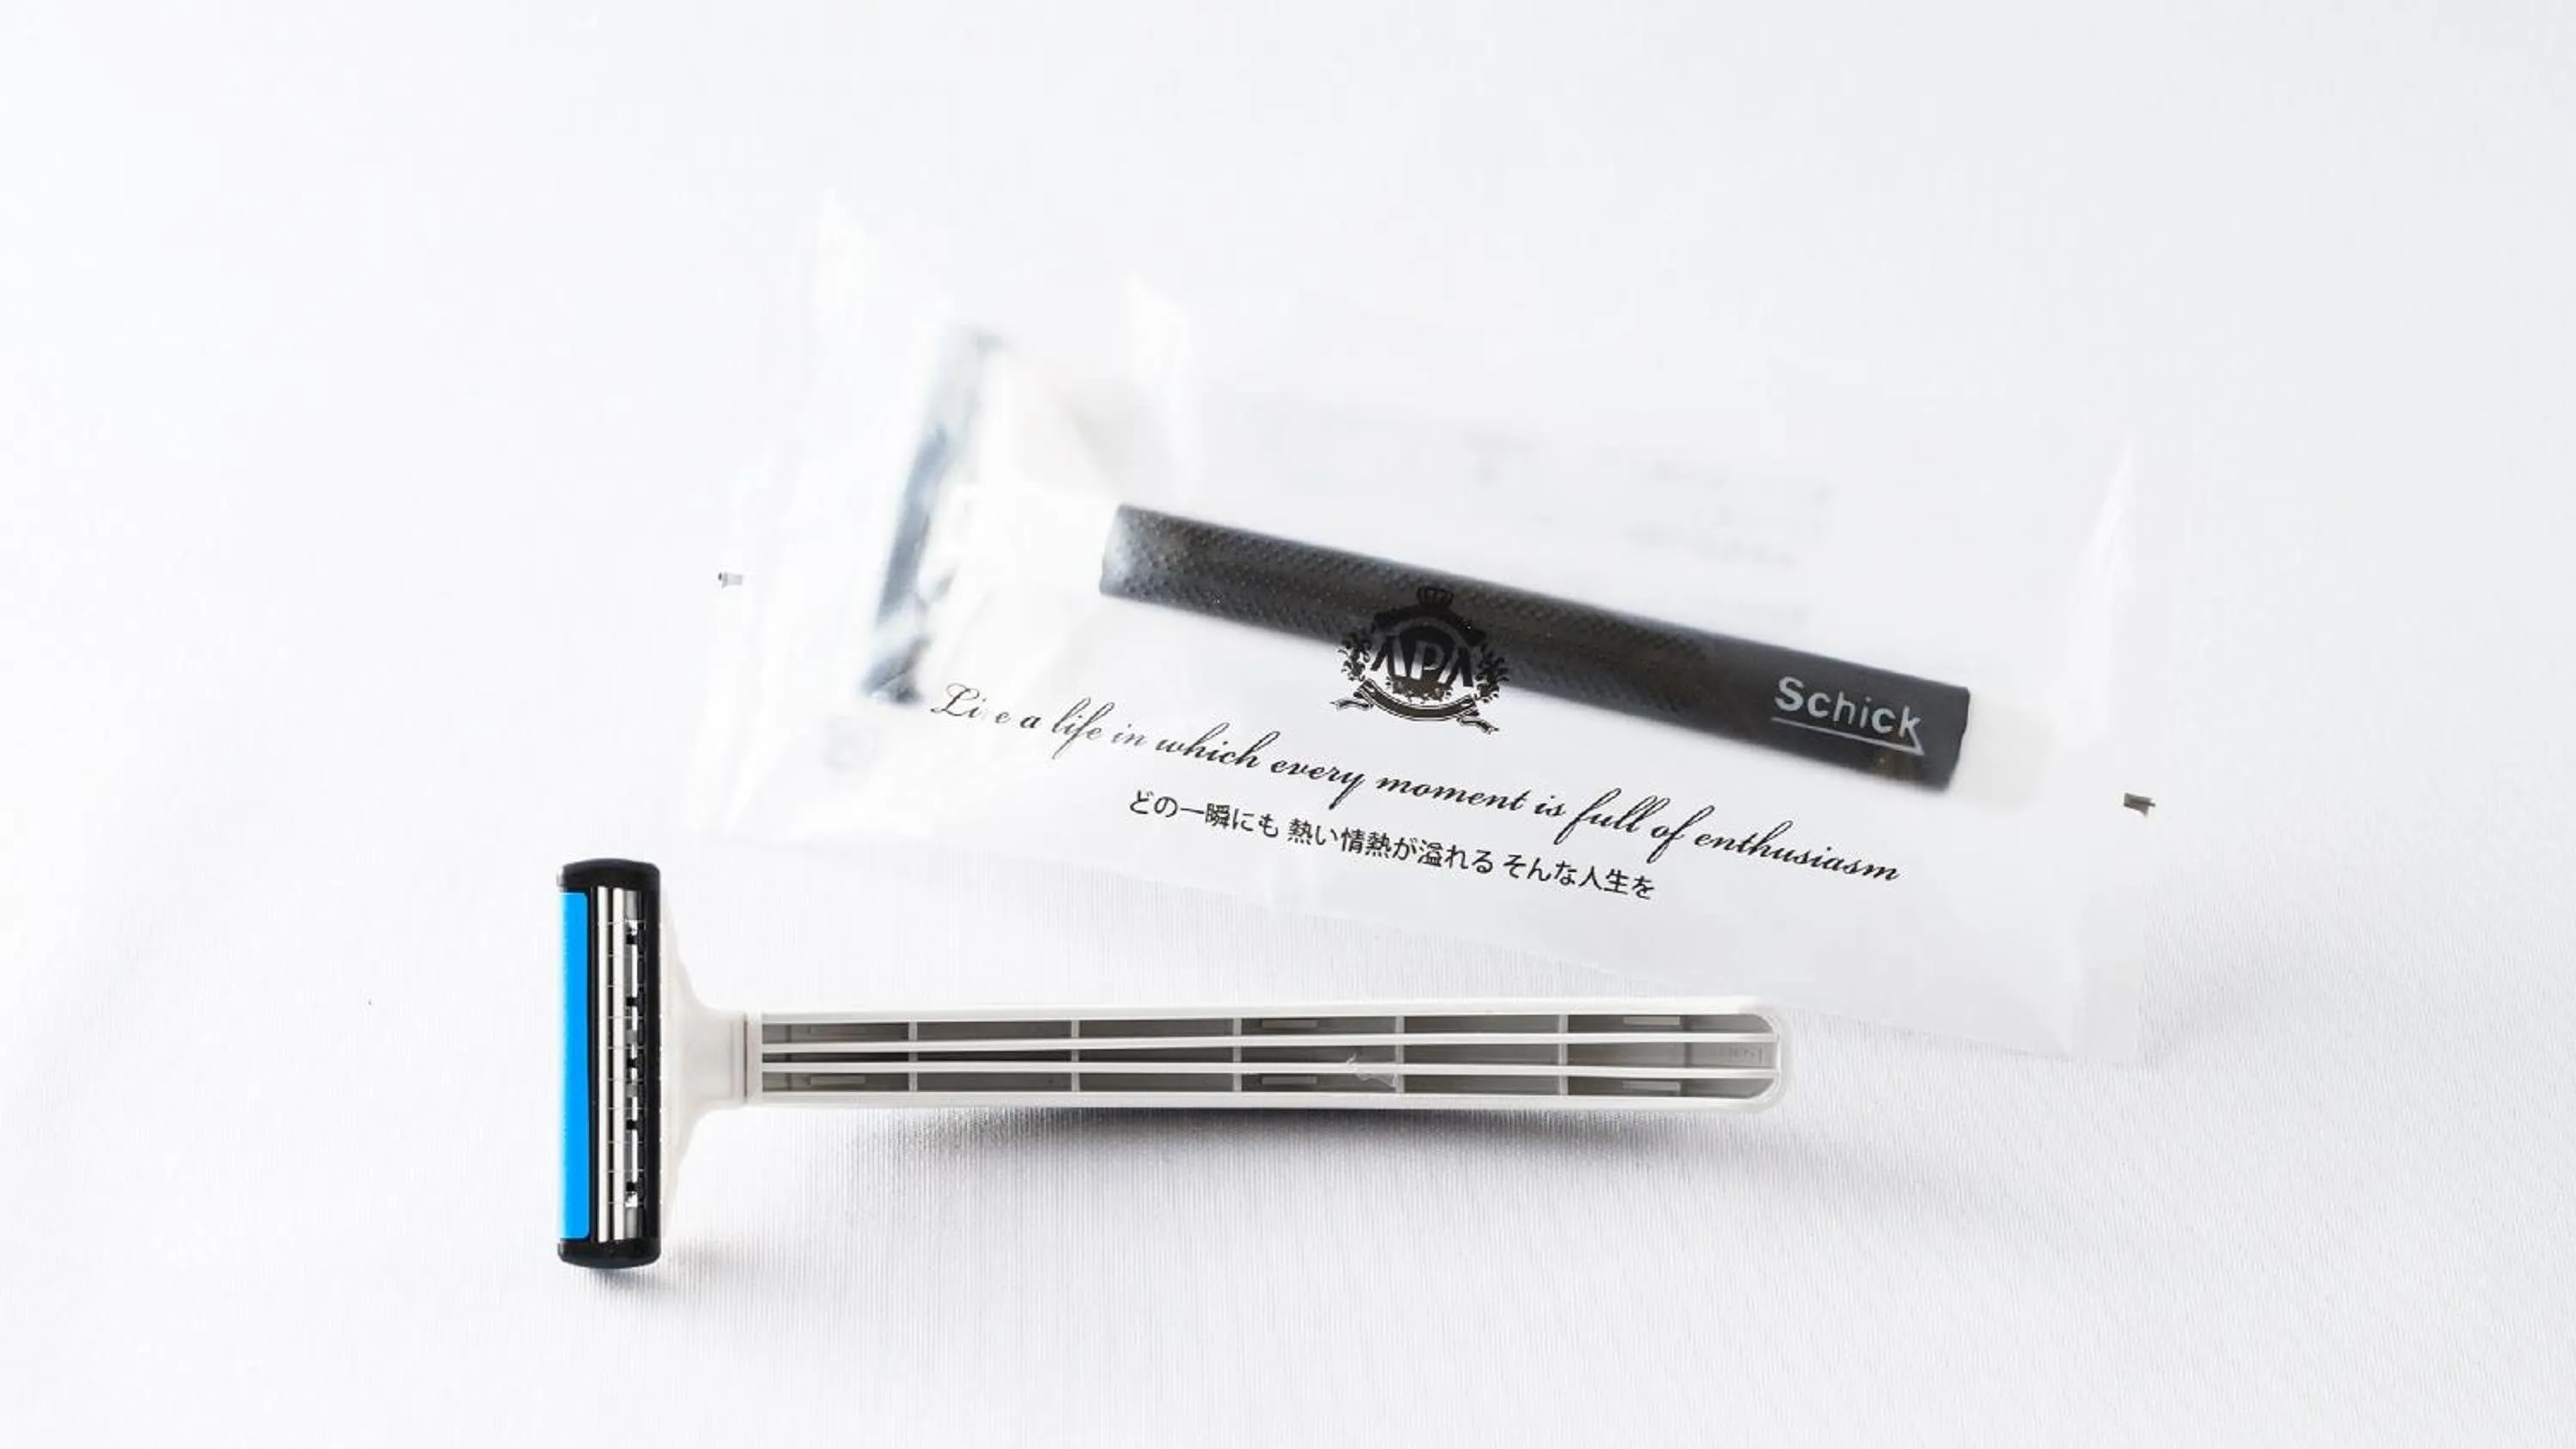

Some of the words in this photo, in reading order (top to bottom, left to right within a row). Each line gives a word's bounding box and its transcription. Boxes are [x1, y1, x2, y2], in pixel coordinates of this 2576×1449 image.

[1774, 676, 1922, 743] Schick
[931, 682, 1012, 724] Lie
[1019, 714, 1042, 729] a
[1051, 696, 1115, 760] life
[1110, 723, 1145, 747] in
[1156, 722, 1279, 769] which
[1271, 758, 1365, 809] every
[1376, 776, 1531, 812] moment
[1534, 793, 1565, 817] is
[1554, 787, 1671, 845] full
[1650, 805, 1715, 863] of
[1694, 820, 1901, 882] enthusiasm
[1129, 790, 1279, 838] どの一瞬にも
[1287, 817, 1494, 875] 熱い情熱が溢れる
[1503, 853, 1656, 900] そんな人生を
